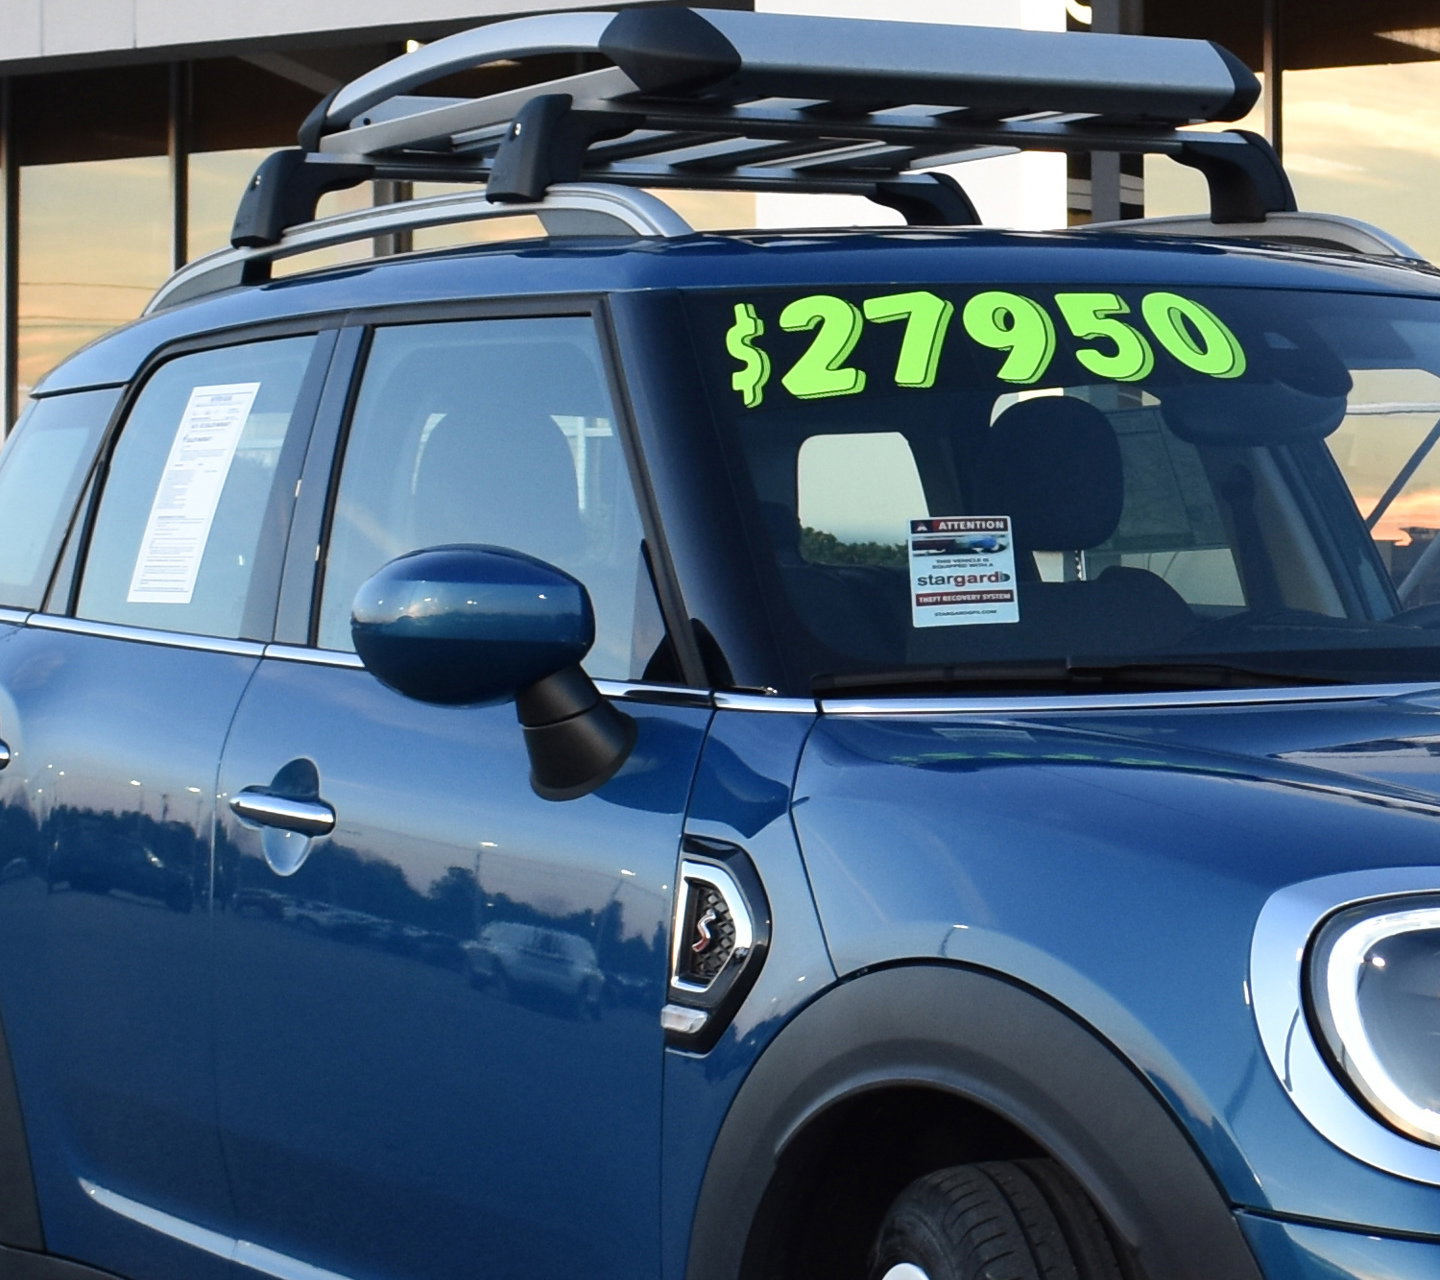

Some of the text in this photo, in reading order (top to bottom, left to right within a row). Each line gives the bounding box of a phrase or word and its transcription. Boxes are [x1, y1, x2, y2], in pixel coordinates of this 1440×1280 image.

[725, 290, 1247, 409] $27950
[938, 520, 1005, 531] ATTENTION
[917, 571, 1000, 588] stargard
[918, 592, 1011, 604] THEFT RECOVERY SYSTEM
